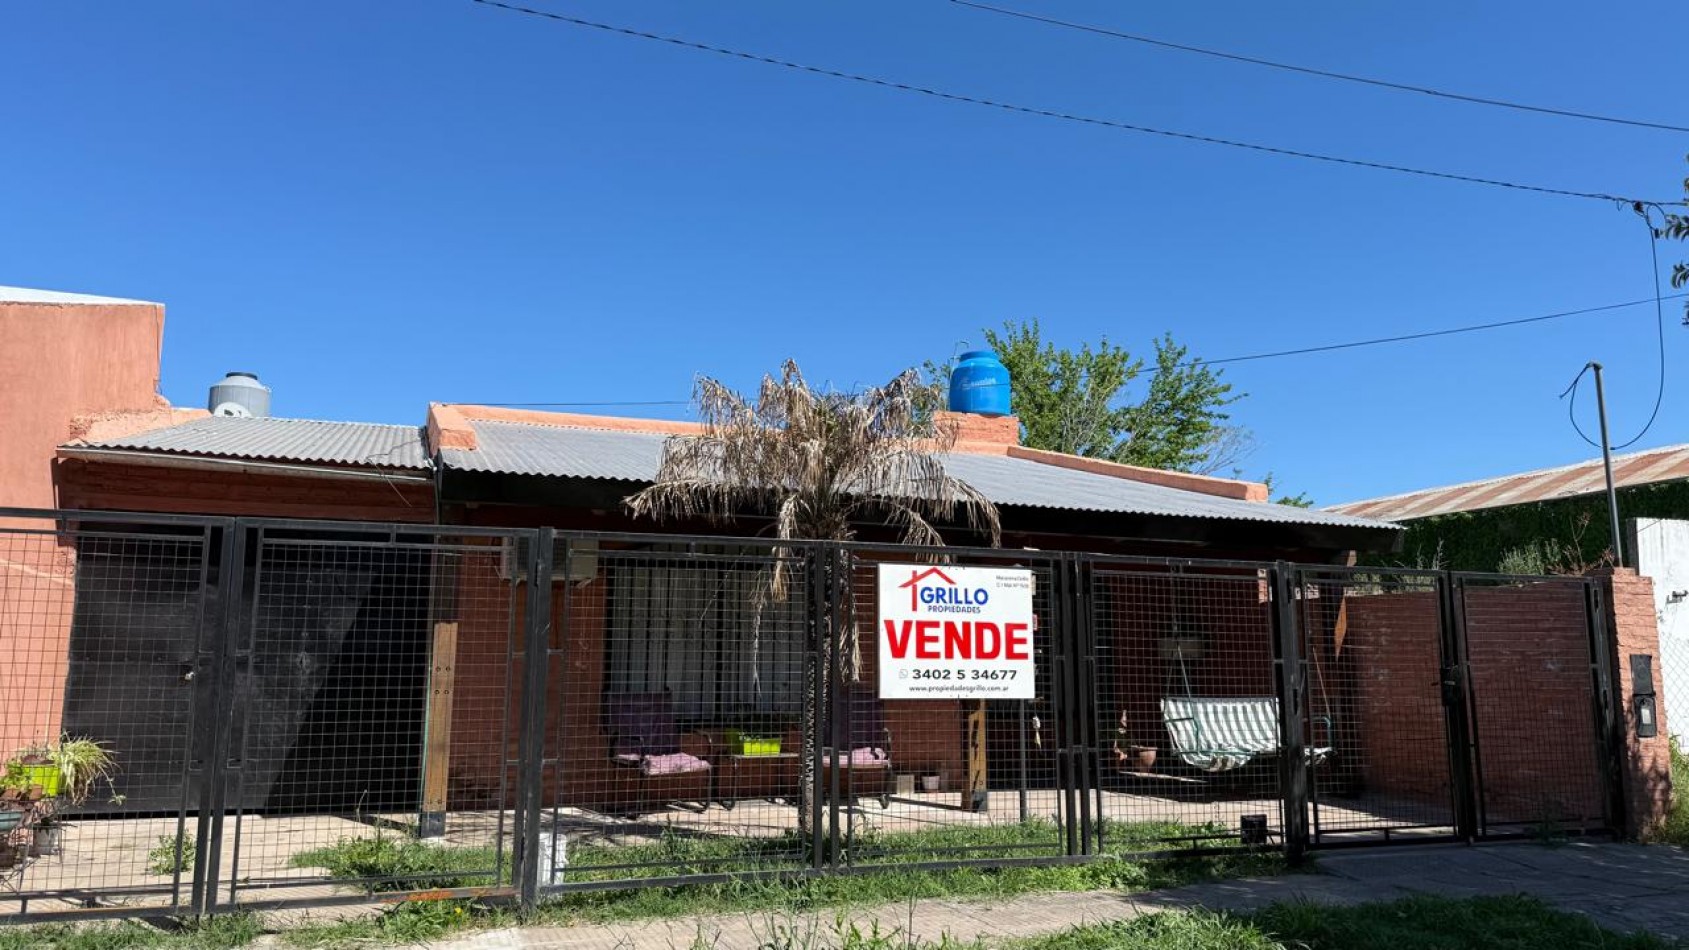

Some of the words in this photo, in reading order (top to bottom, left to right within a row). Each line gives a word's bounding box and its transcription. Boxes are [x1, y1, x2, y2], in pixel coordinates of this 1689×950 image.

[920, 586, 989, 605] GRILLO
[927, 605, 981, 614] PROPIEDADES
[883, 619, 1029, 660] VENDE
[912, 669, 951, 680] 3402
[956, 669, 966, 680] 5
[971, 669, 1017, 680] 34677
[909, 684, 1009, 693] www.propiedadesgrillo.com.ar
